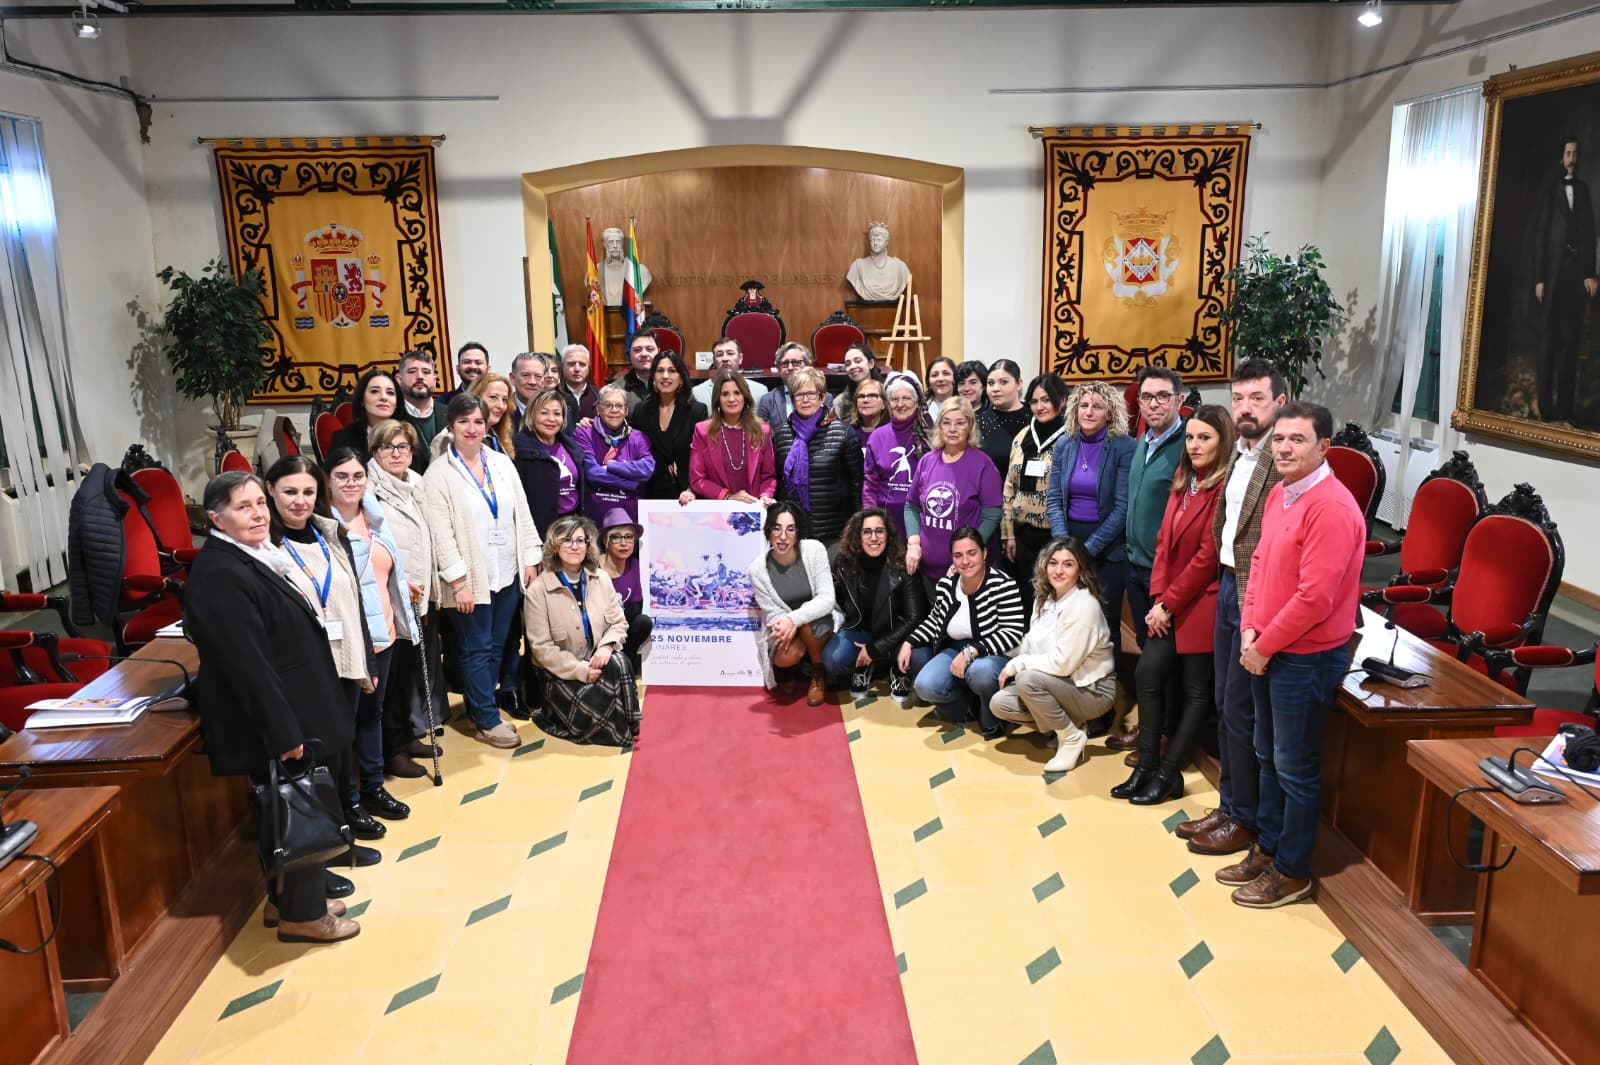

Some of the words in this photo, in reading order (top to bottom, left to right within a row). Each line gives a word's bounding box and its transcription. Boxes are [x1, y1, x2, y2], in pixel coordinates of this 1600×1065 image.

[925, 515, 952, 530] VELA
[650, 634, 664, 642] 25
[667, 635, 732, 643] NOVIEMBRE
